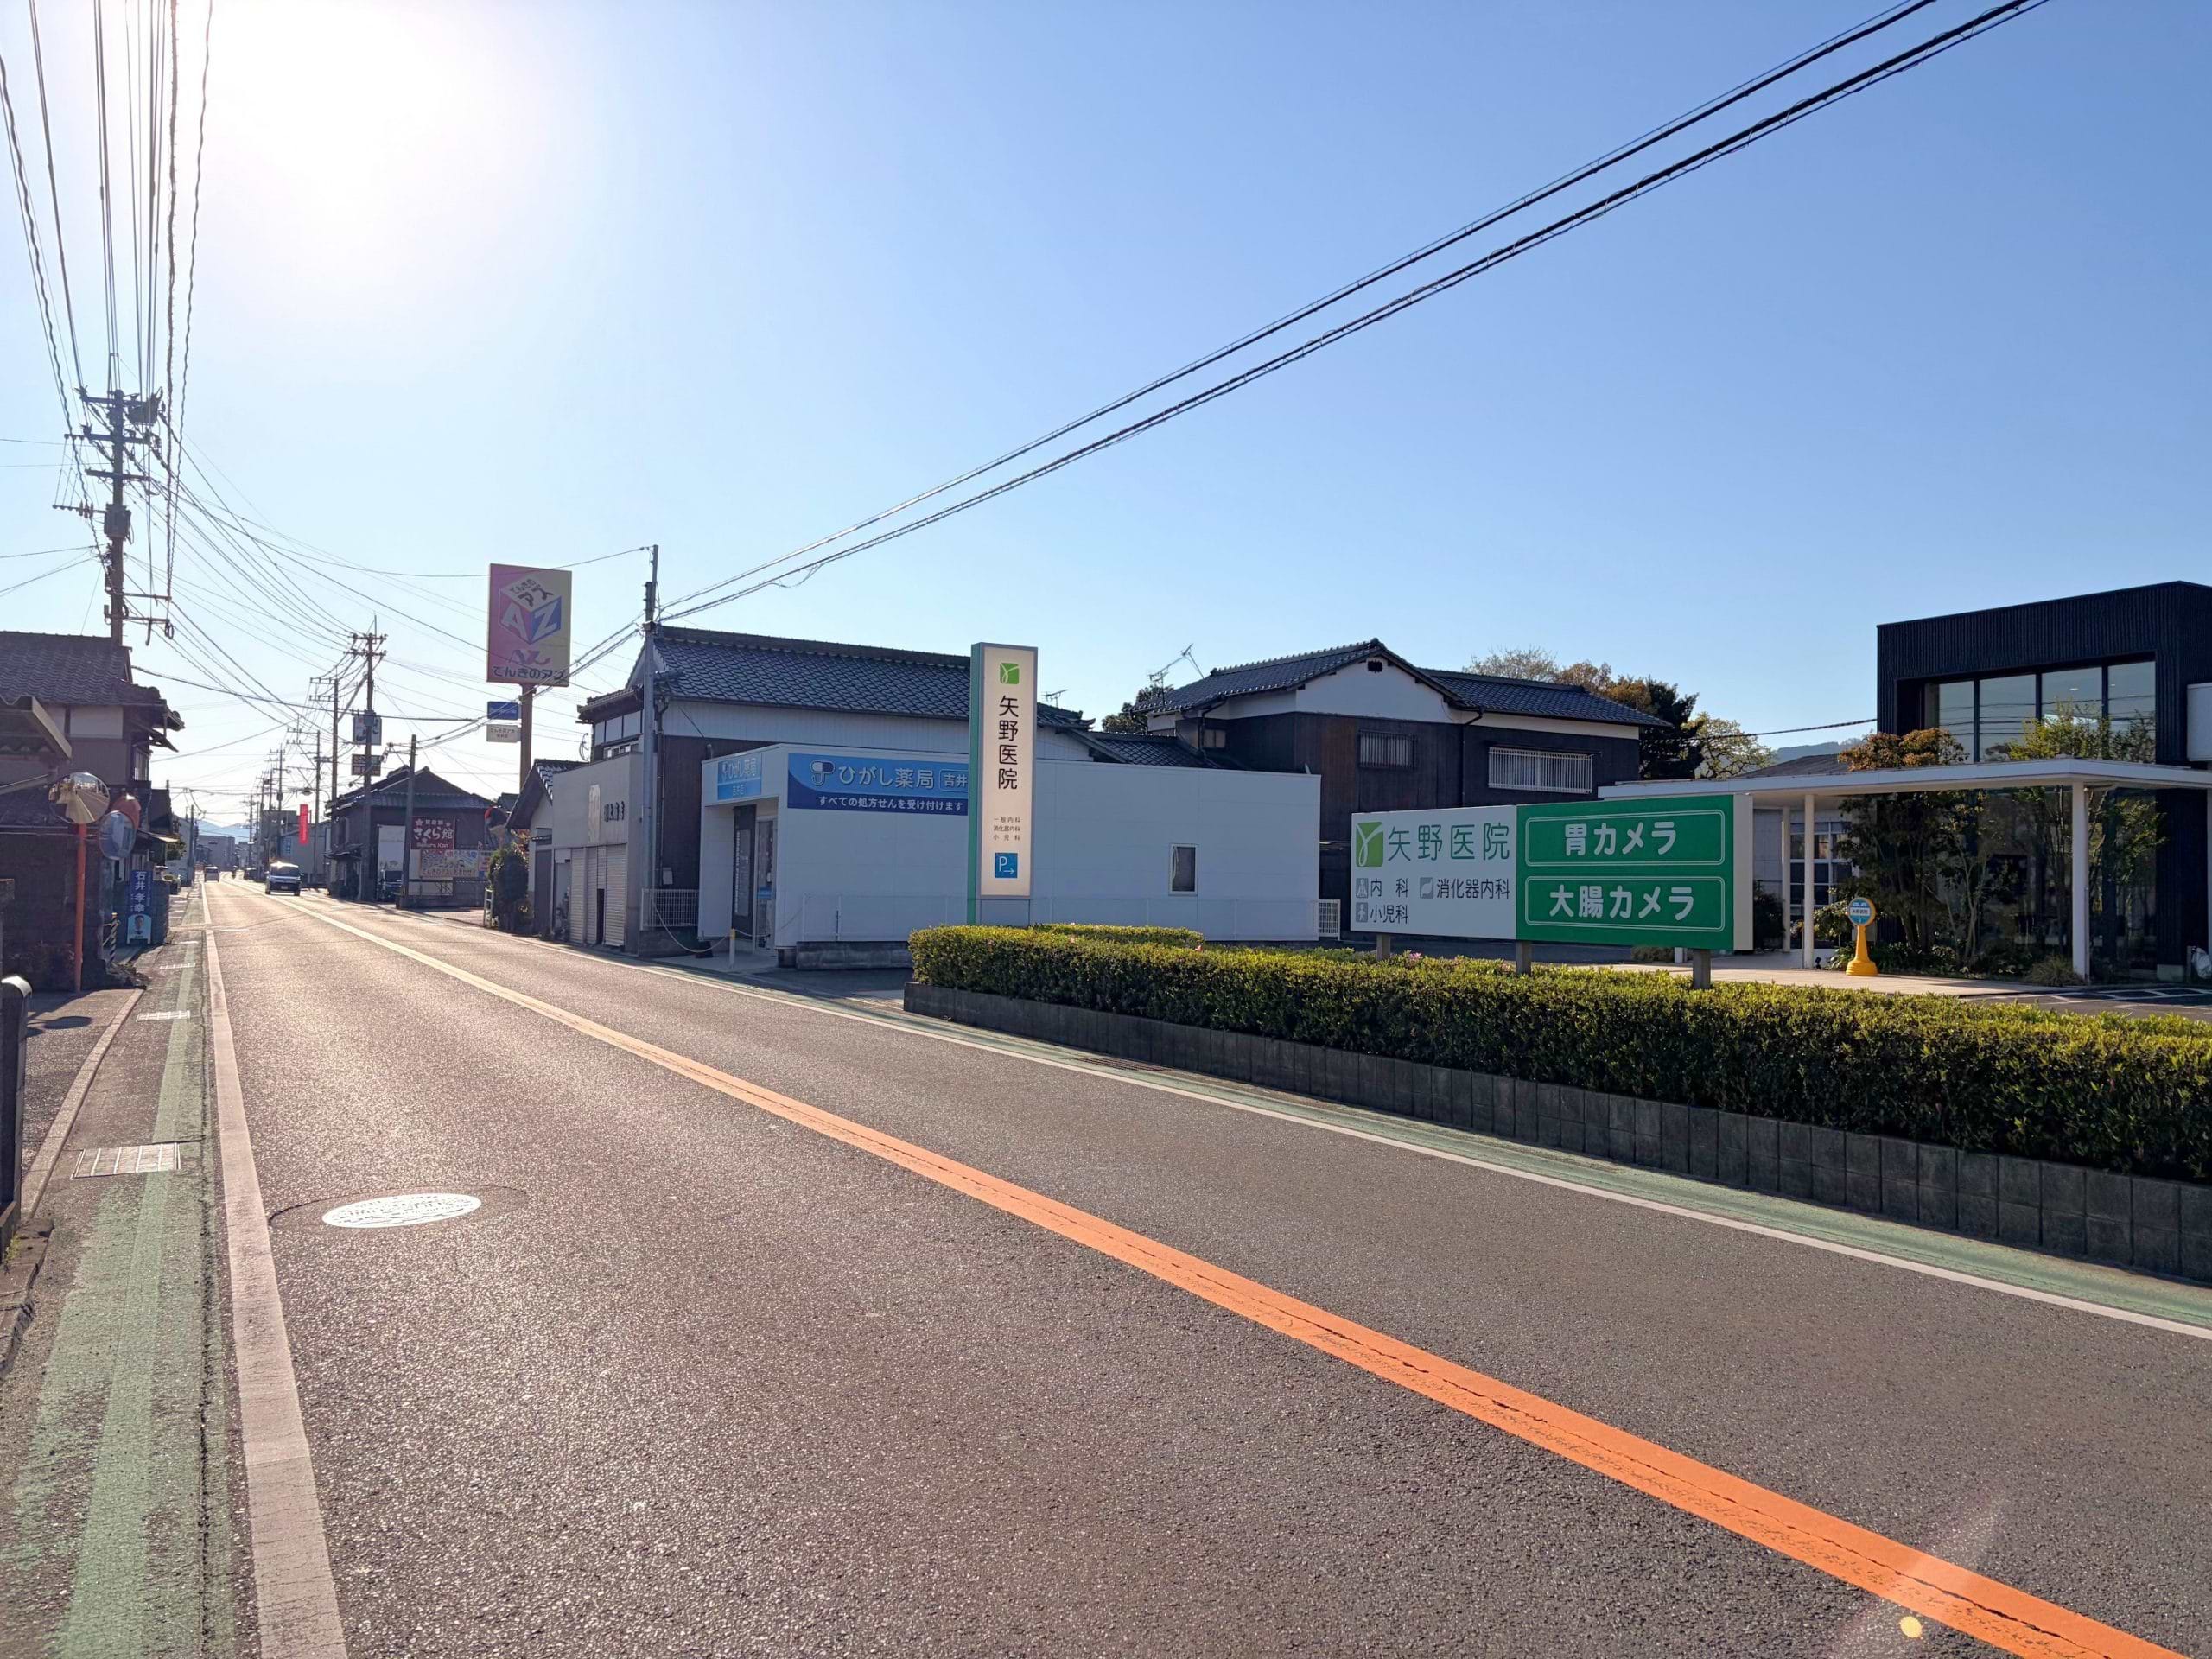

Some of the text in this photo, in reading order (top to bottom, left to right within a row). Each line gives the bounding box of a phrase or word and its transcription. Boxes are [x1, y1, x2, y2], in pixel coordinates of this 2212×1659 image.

[998, 695, 1019, 790] 矢野医院
[838, 766, 934, 789] ひがし薬局
[819, 796, 963, 811] すべての処方せんを受け付けます
[1388, 822, 1510, 861] 矢野医院
[1565, 822, 1676, 856] 胃カメラ
[999, 856, 1008, 872] P
[1436, 878, 1510, 899] 消化器内科
[1370, 904, 1409, 924] 小児科
[1549, 884, 1694, 921] 大腸カメラ
